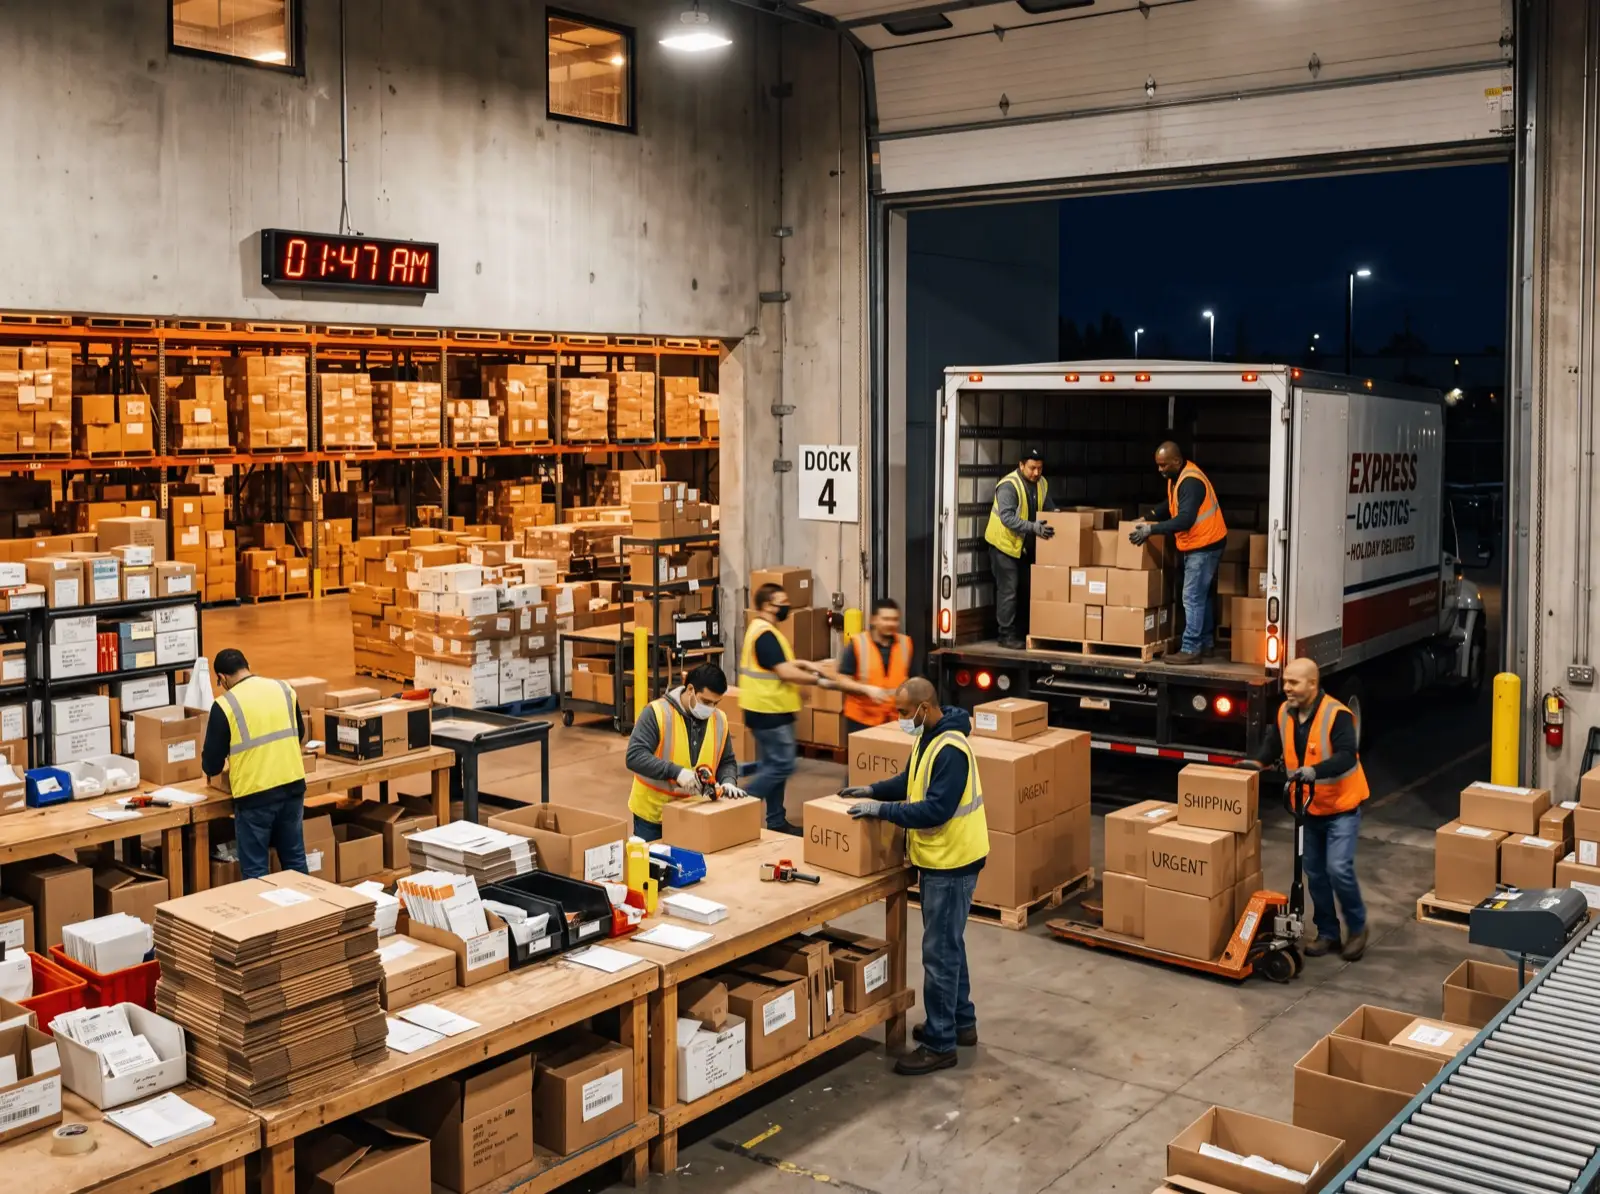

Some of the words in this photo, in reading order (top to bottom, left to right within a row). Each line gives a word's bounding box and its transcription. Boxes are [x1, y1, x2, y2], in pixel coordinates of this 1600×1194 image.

[285, 239, 379, 281] 01:47
[390, 247, 429, 284] AM
[804, 450, 852, 472] DOCK
[1348, 452, 1418, 494] EXPRESS
[817, 477, 837, 515] 4
[1381, 535, 1415, 557] DELIVERIES
[856, 751, 899, 775] GIFTS
[1017, 779, 1050, 804] URGENT
[1183, 792, 1243, 816] SHIPPING
[810, 824, 850, 853] GIFTS
[1151, 850, 1209, 877] URGENT
